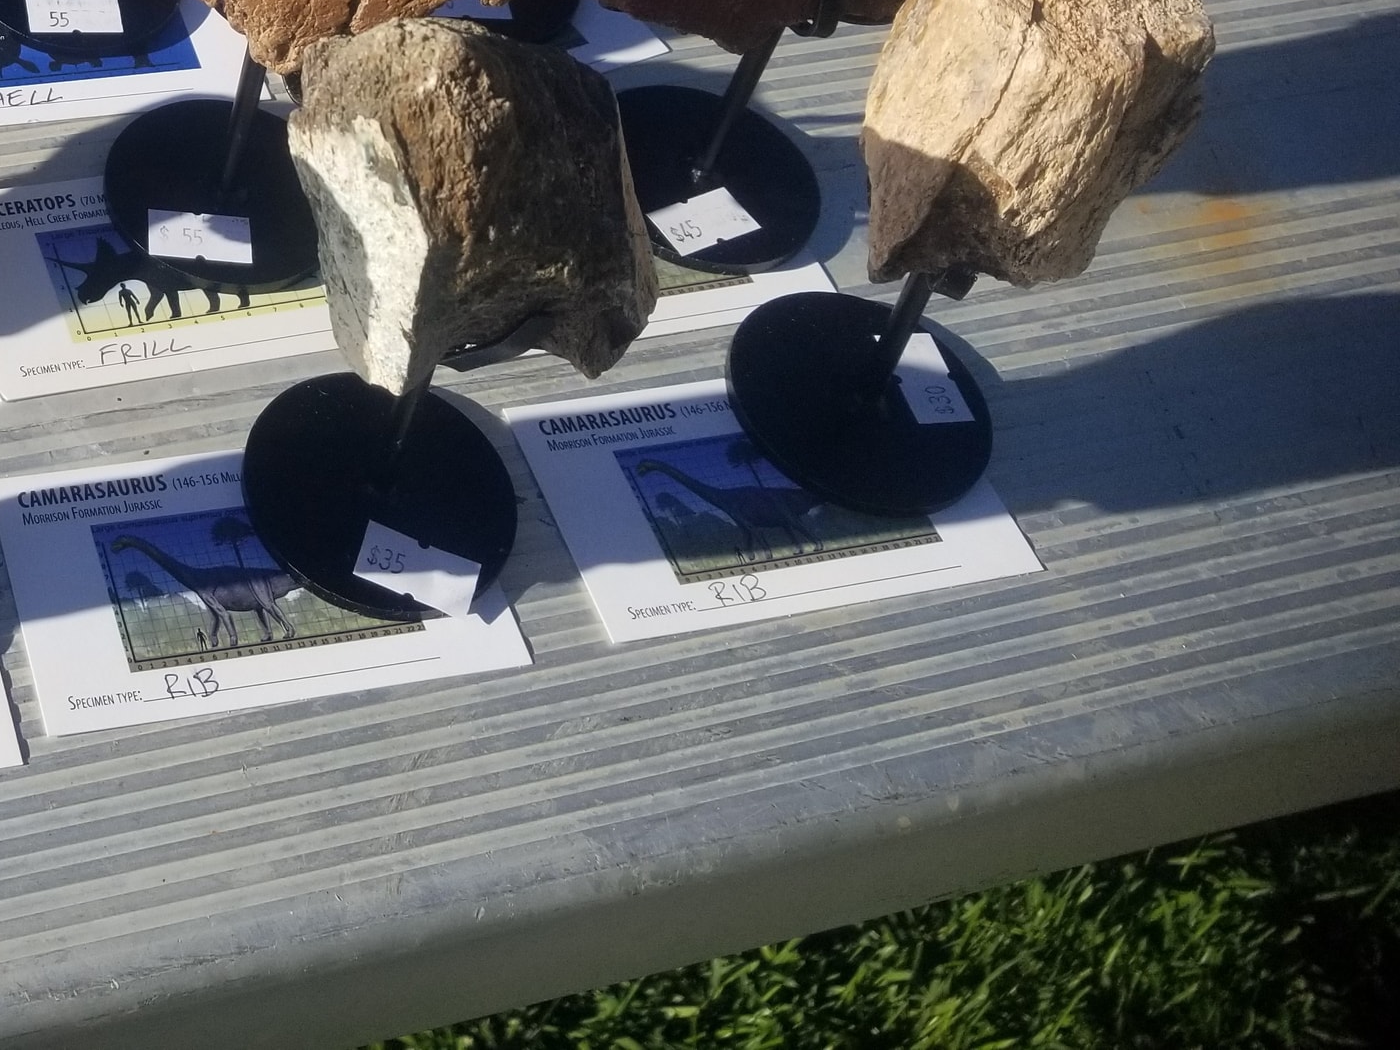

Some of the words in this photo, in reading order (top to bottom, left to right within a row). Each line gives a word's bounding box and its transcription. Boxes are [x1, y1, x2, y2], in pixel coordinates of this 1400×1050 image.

[49, 11, 69, 27] 55
[80, 195, 95, 207] (70
[25, 216, 45, 227] HELL
[47, 214, 70, 224] CREEK
[72, 209, 107, 220] FORMATI
[670, 220, 702, 243] $45
[183, 227, 203, 245] 55
[20, 363, 60, 377] SPECIMEN
[63, 360, 85, 371] TYPE:
[99, 339, 192, 365] FRILL
[925, 386, 954, 413] $30
[539, 403, 676, 436] CAMARASAURUS
[680, 402, 722, 418] (146-156
[547, 436, 591, 452] MORRISON
[592, 431, 637, 447] FORMATION
[638, 426, 676, 439] JURASSIC
[18, 474, 167, 508] CAMARASAURUS
[172, 475, 219, 491] (146-156
[222, 471, 241, 484] MILL
[22, 510, 69, 526] MORRISON
[72, 505, 121, 521] FORMATION
[124, 499, 162, 514] JURASSIC
[367, 545, 406, 574] $35
[627, 605, 671, 620] SPECIMEN
[673, 601, 696, 615] TYPE:
[709, 574, 767, 607] RIB
[68, 693, 115, 710] SPECIMEN
[116, 690, 143, 703] TYPE:
[164, 668, 219, 700] RIB
